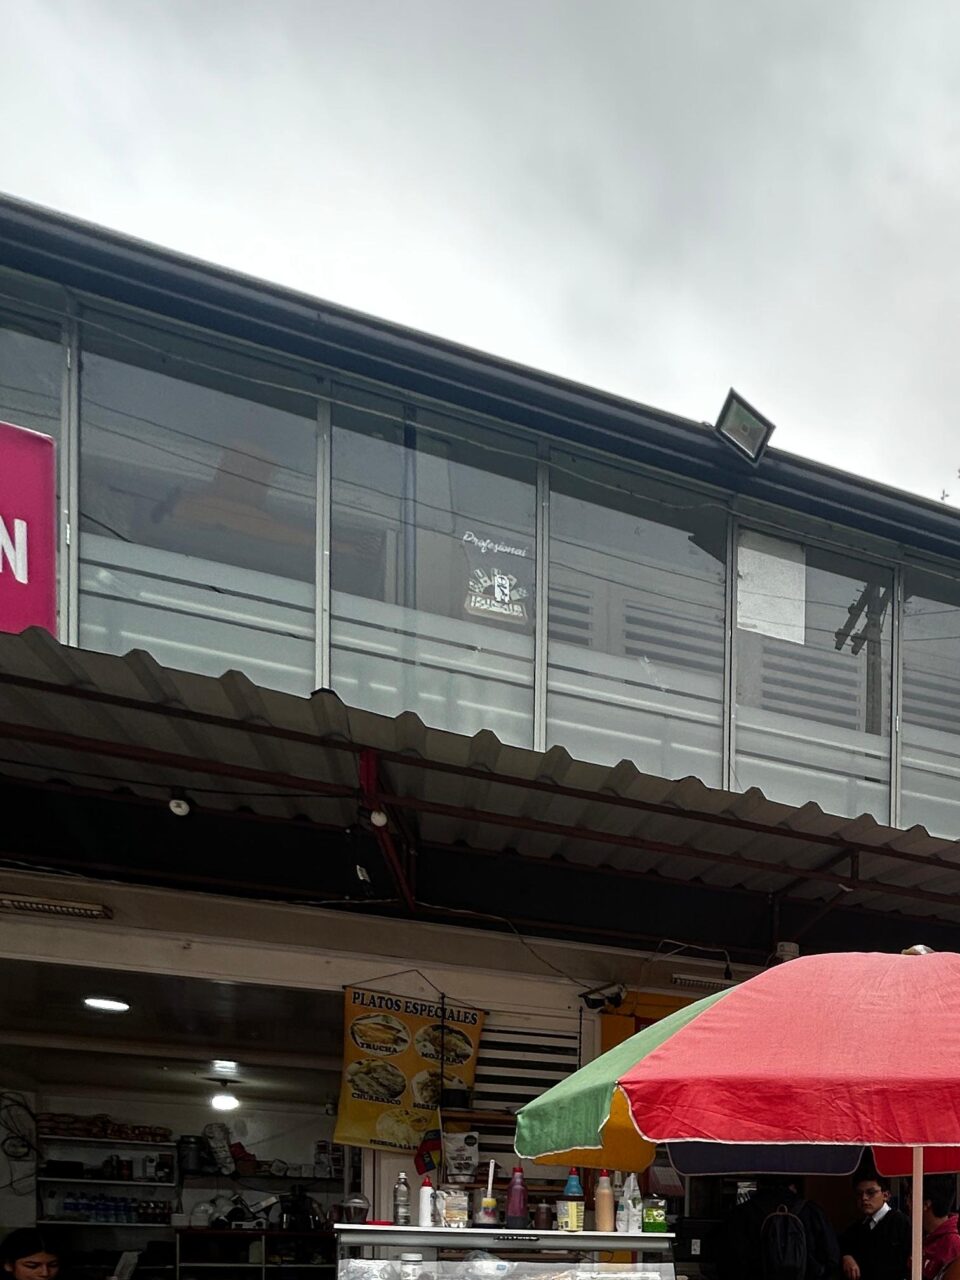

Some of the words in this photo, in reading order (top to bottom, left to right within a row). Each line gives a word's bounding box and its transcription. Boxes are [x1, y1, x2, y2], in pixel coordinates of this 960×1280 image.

[352, 991, 401, 1012] PLATOS
[404, 1000, 478, 1025] ESPECIALES
[359, 1042, 398, 1054] TRUCHA
[351, 1092, 401, 1106] CHURRASCO
